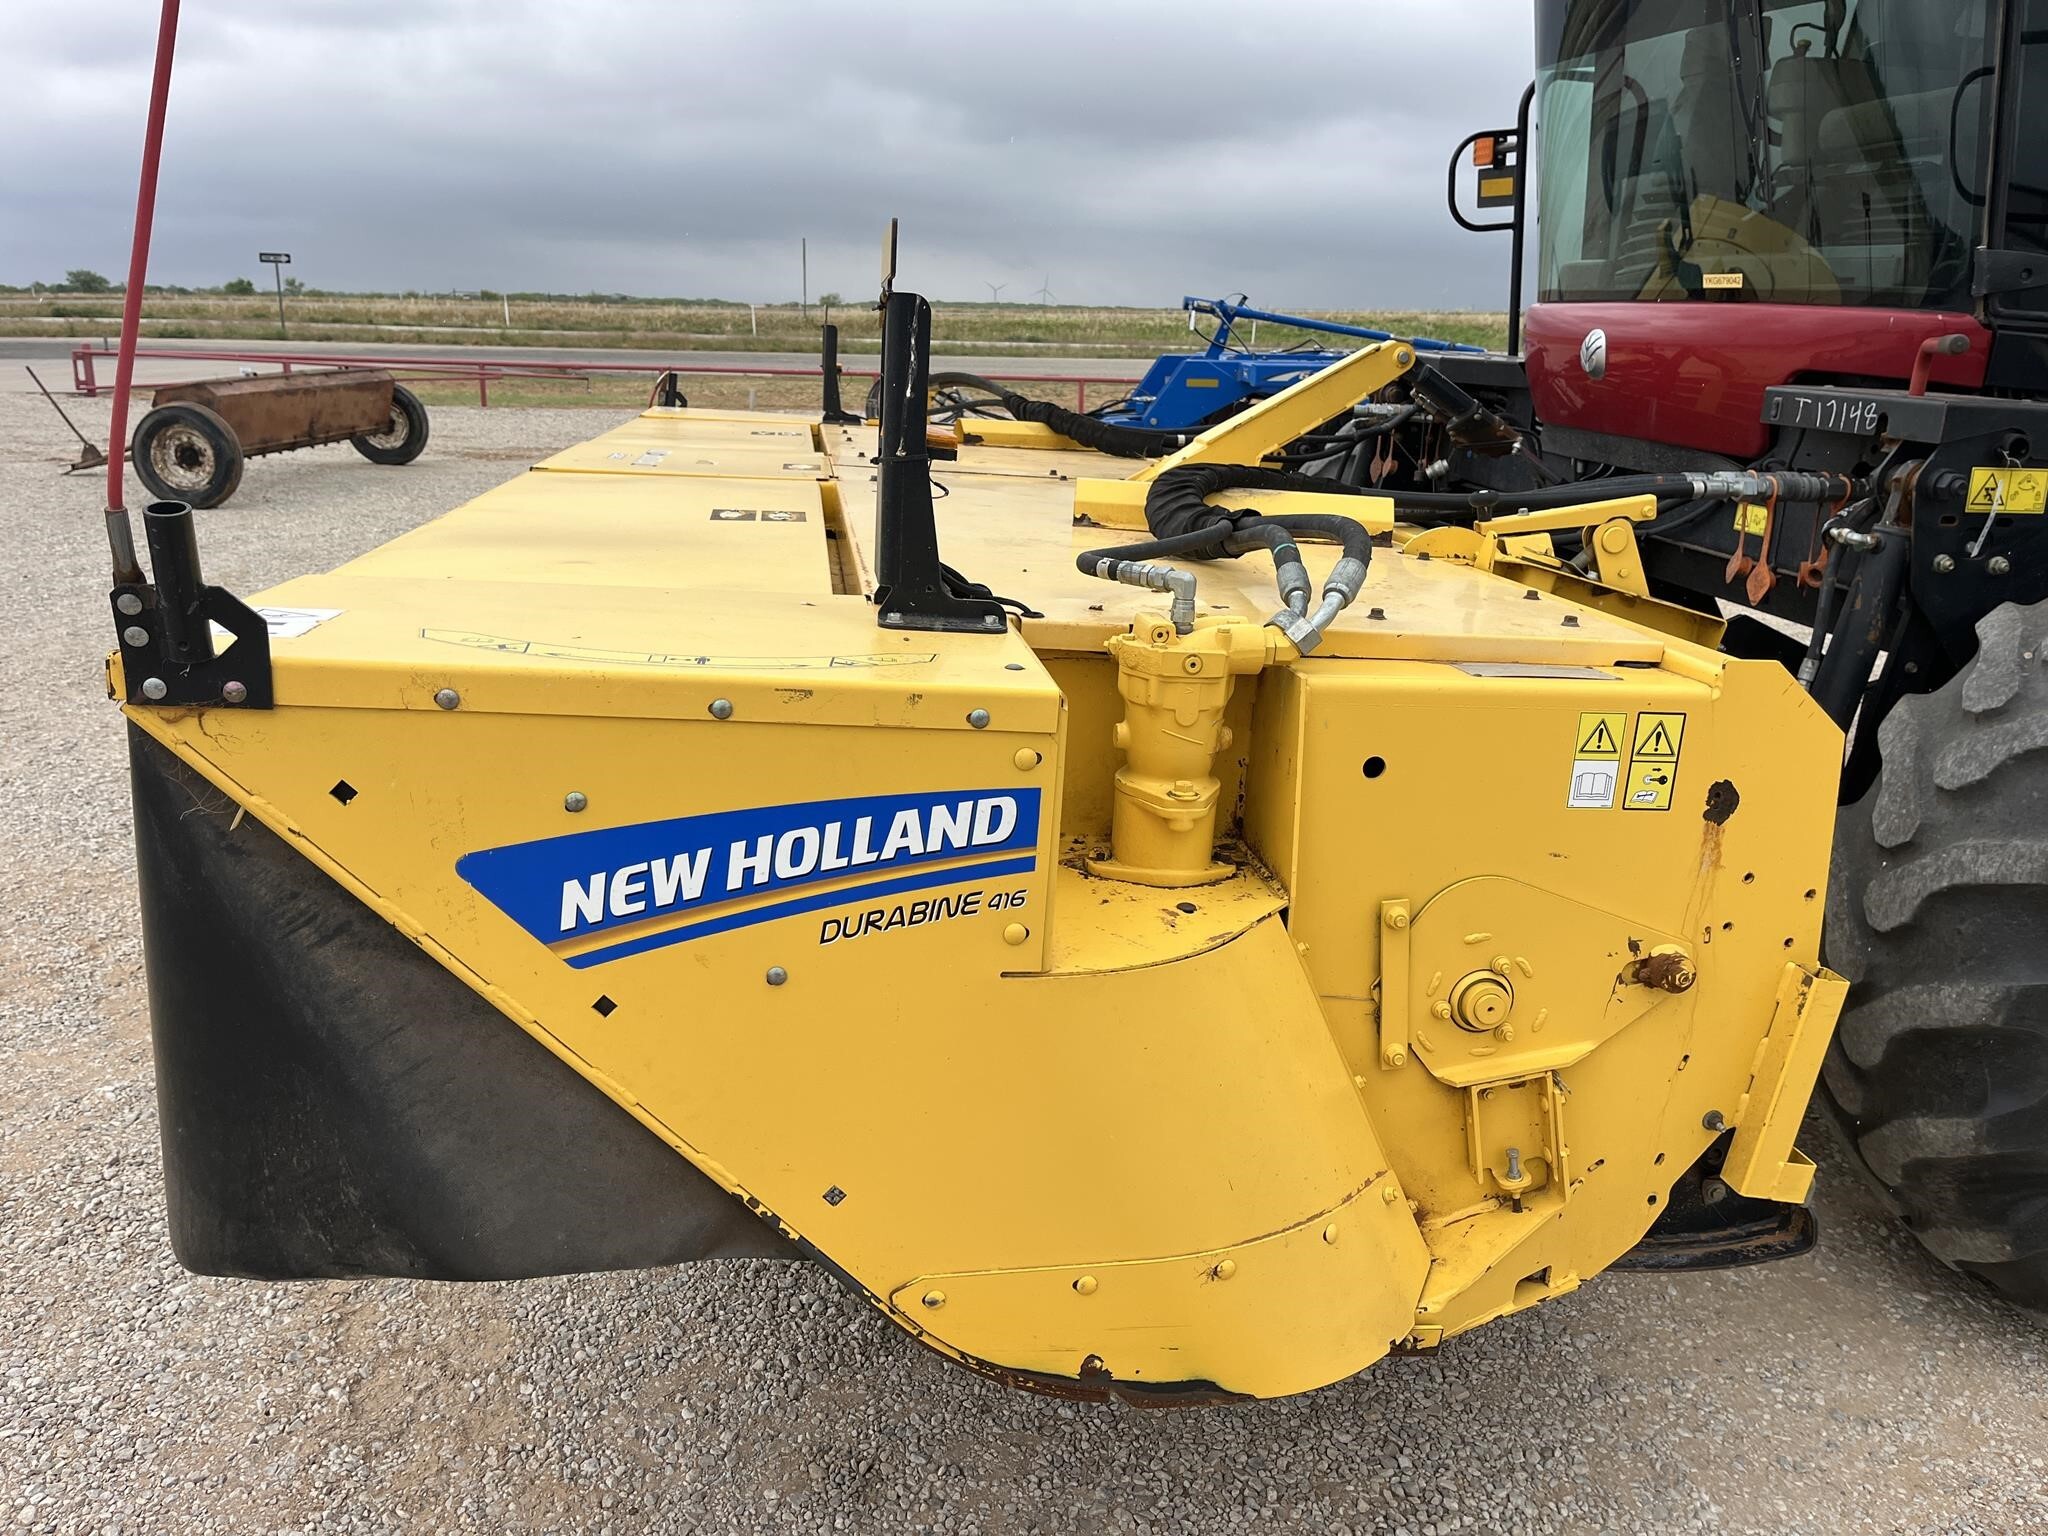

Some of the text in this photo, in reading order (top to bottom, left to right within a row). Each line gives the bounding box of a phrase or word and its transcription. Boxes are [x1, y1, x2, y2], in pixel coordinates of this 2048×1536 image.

[1794, 397, 1878, 433] T17148
[559, 796, 1018, 932] NEW HOLLAND
[819, 890, 1027, 945] DURABINE 416
